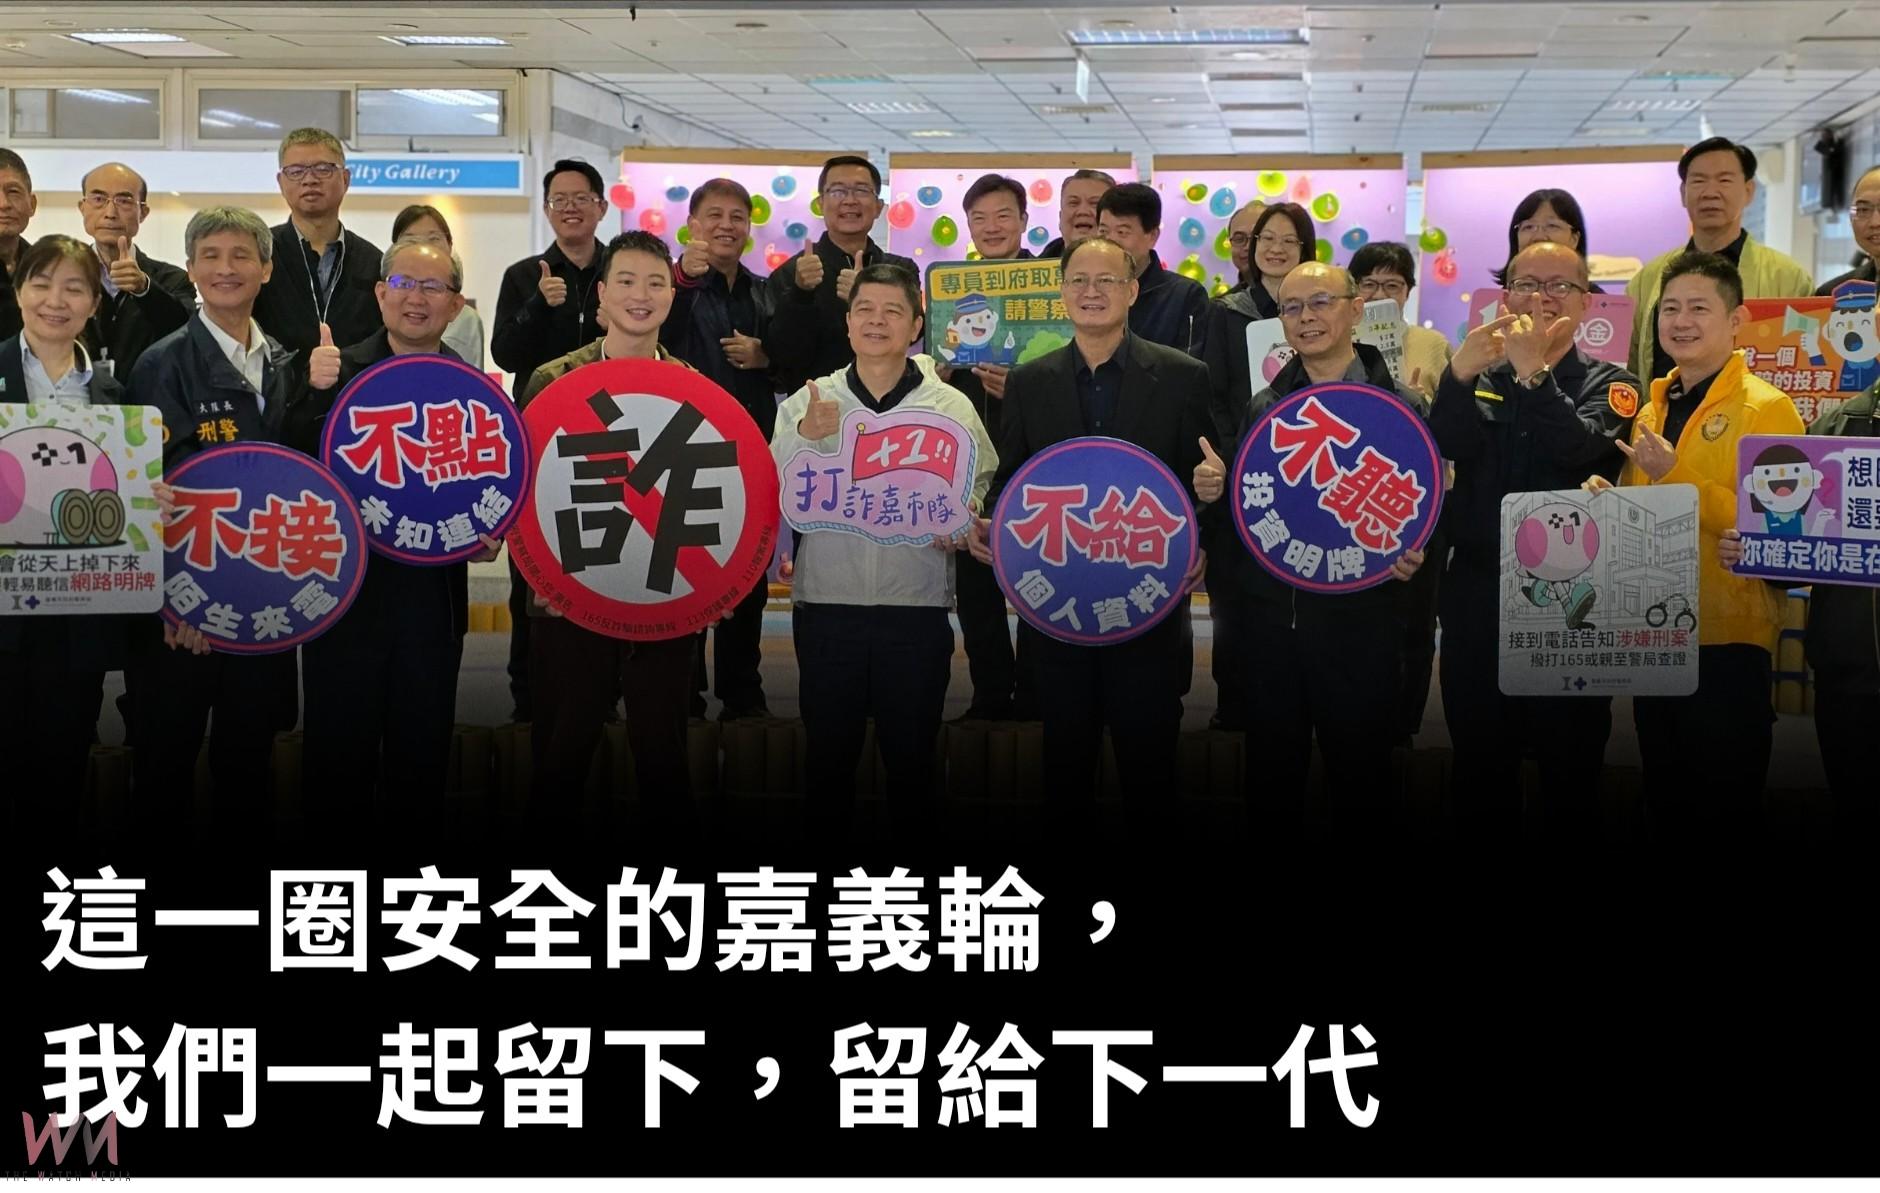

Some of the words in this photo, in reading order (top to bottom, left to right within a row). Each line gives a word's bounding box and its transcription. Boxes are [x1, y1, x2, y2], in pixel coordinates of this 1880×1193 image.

[385, 164, 460, 184] Gallery
[196, 418, 239, 442] 刑警
[336, 399, 512, 492] 不點
[554, 387, 738, 596] 詐
[1270, 395, 1426, 557] 不聽
[1847, 456, 1880, 488] 想
[163, 487, 348, 582] 不接
[360, 485, 512, 552] 未知連結
[1004, 484, 1187, 570] 不給
[1242, 471, 1366, 583] 投資明牌
[1847, 497, 1880, 530] 還
[164, 570, 339, 641] 陌生來電
[1014, 569, 1170, 633] 個人資料
[1508, 629, 1689, 649] 接到電話告知涉嫌刑案
[1530, 652, 1687, 667] 撥打165或親至警局查證
